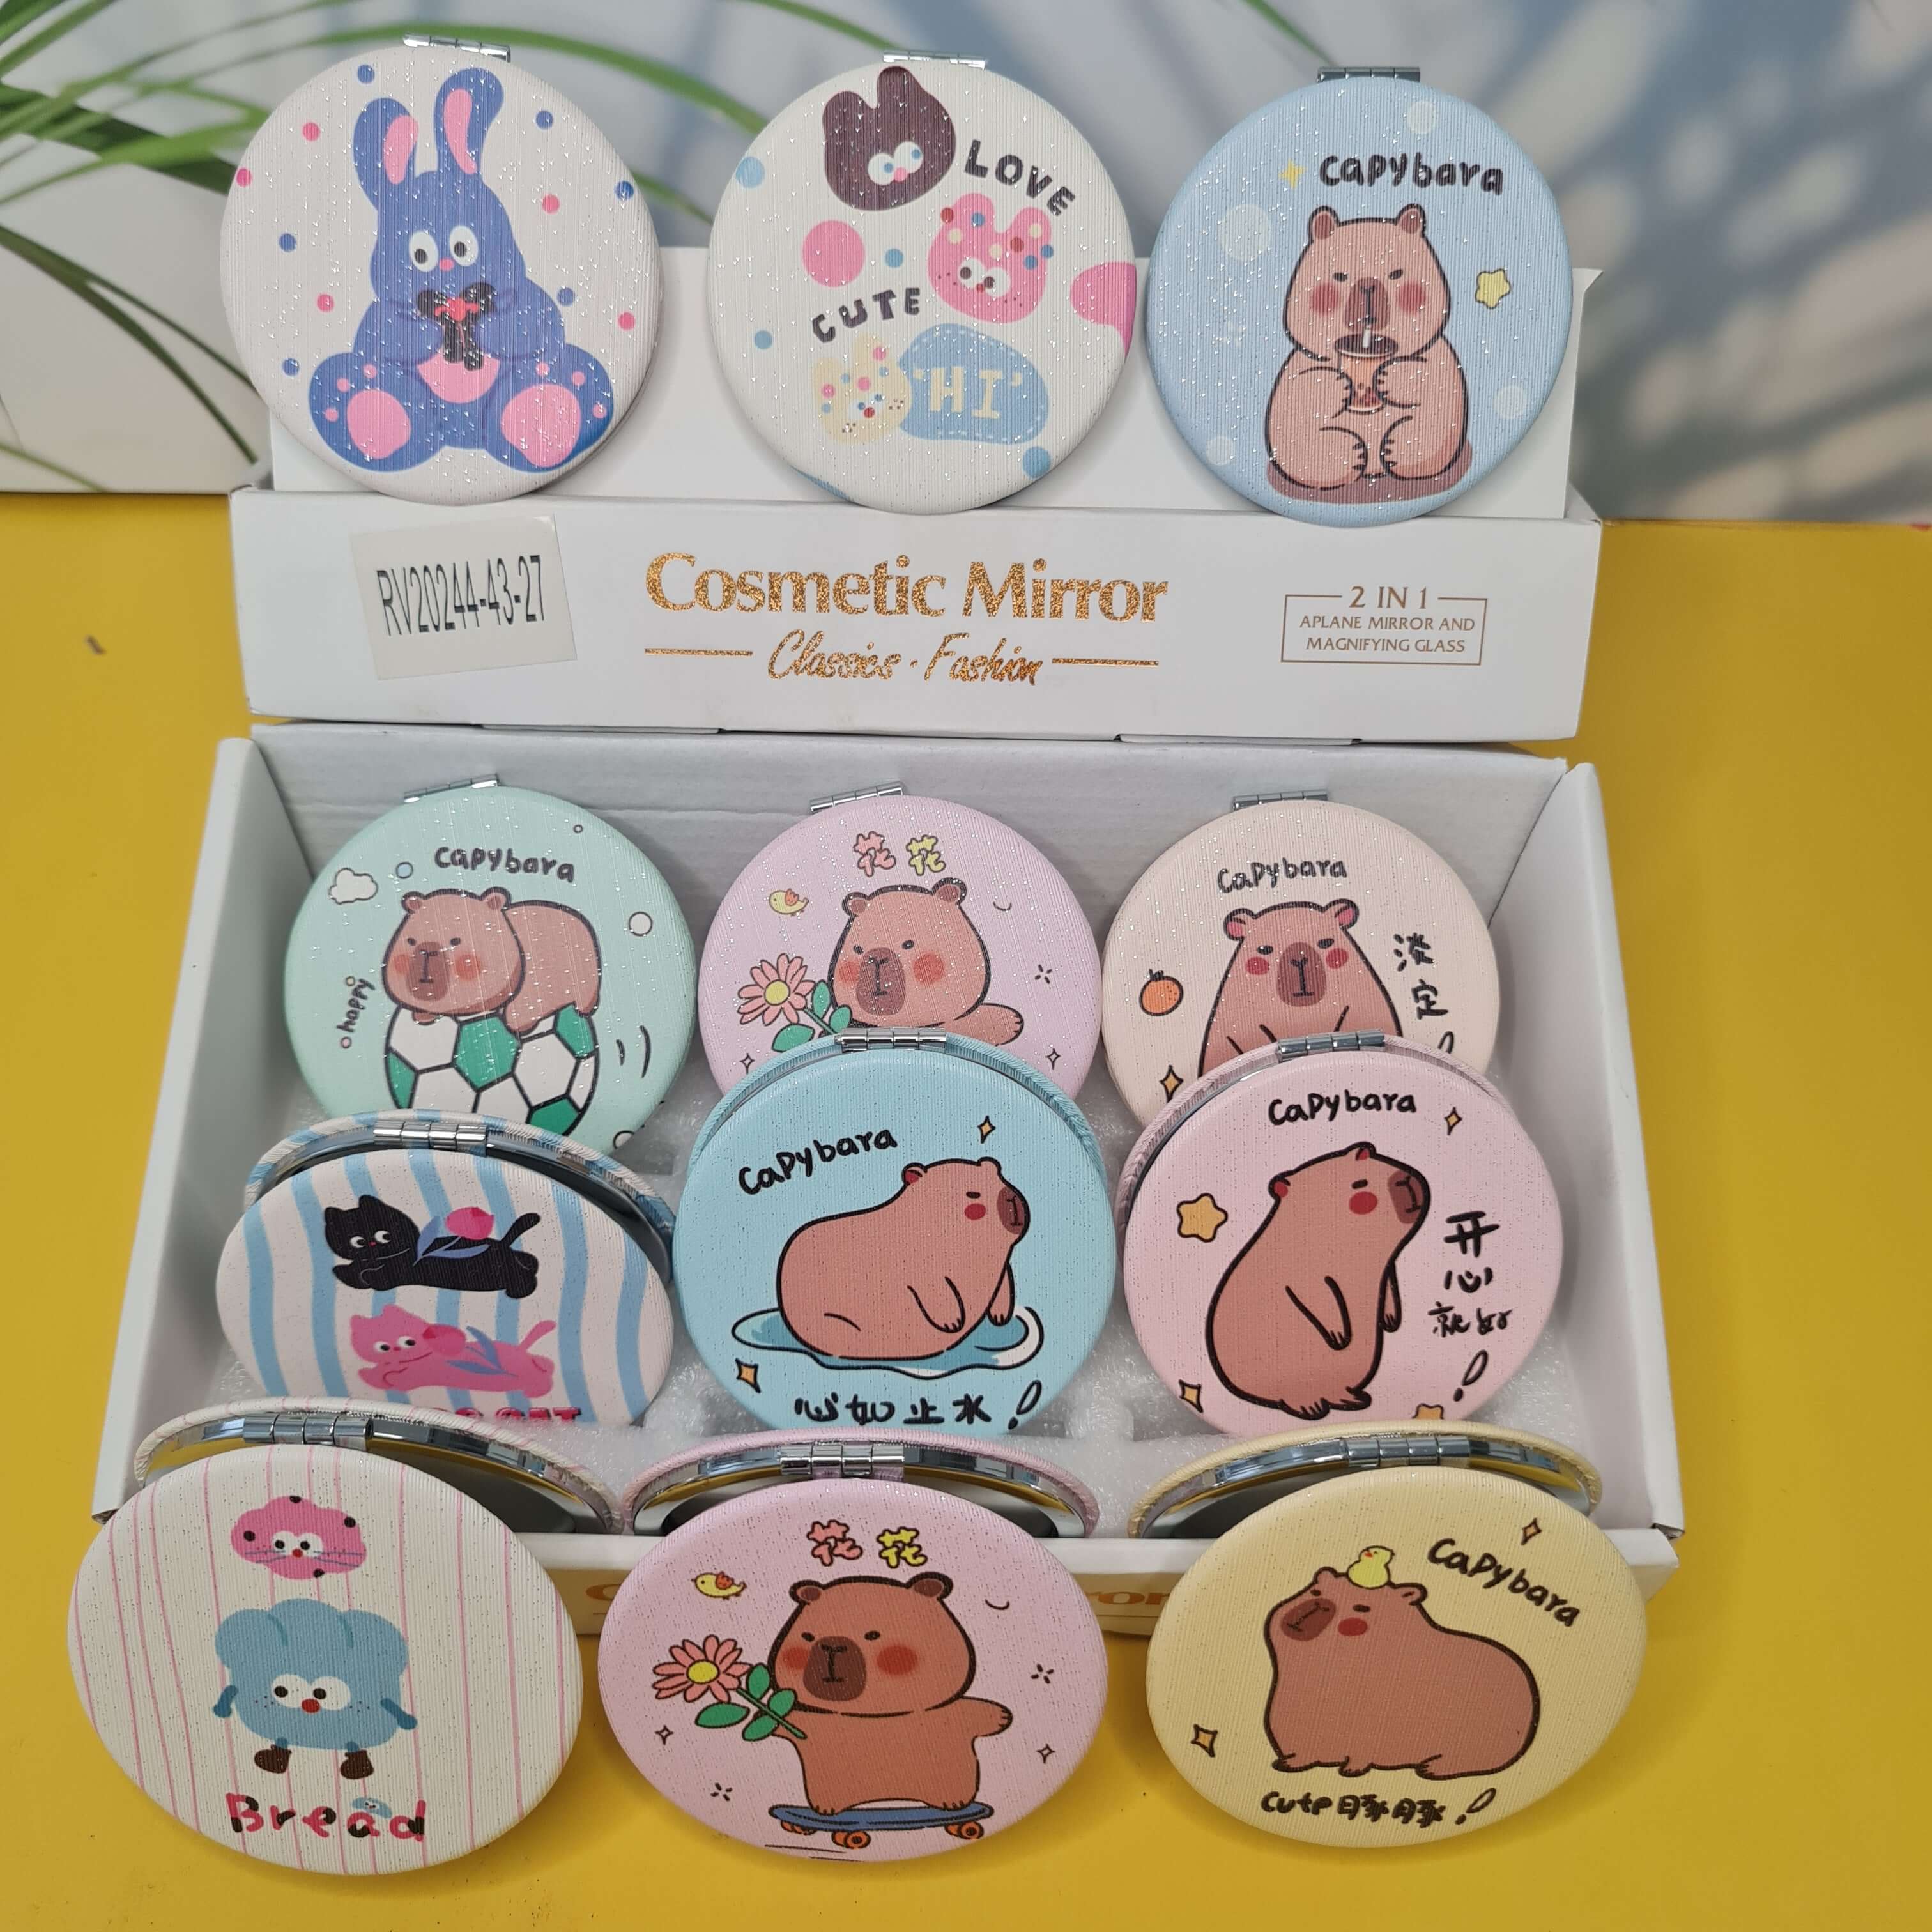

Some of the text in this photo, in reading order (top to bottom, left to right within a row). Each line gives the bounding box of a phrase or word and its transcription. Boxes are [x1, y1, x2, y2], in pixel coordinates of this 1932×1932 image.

[964, 139, 1075, 215] LOVE
[811, 288, 920, 343] CUTE
[377, 554, 546, 638] RV20244-43-27
[645, 552, 1169, 622] Cosmetic Mirror
[1349, 586, 1427, 609] 2 IN 1
[1306, 637, 1465, 653] MAGNIFYING GLASS
[1368, 617, 1434, 631] MIRROR
[1438, 618, 1475, 631] AND
[767, 629, 1044, 686] Classics Fashion
[336, 978, 376, 1033] happy
[225, 1792, 426, 1843] Bread
